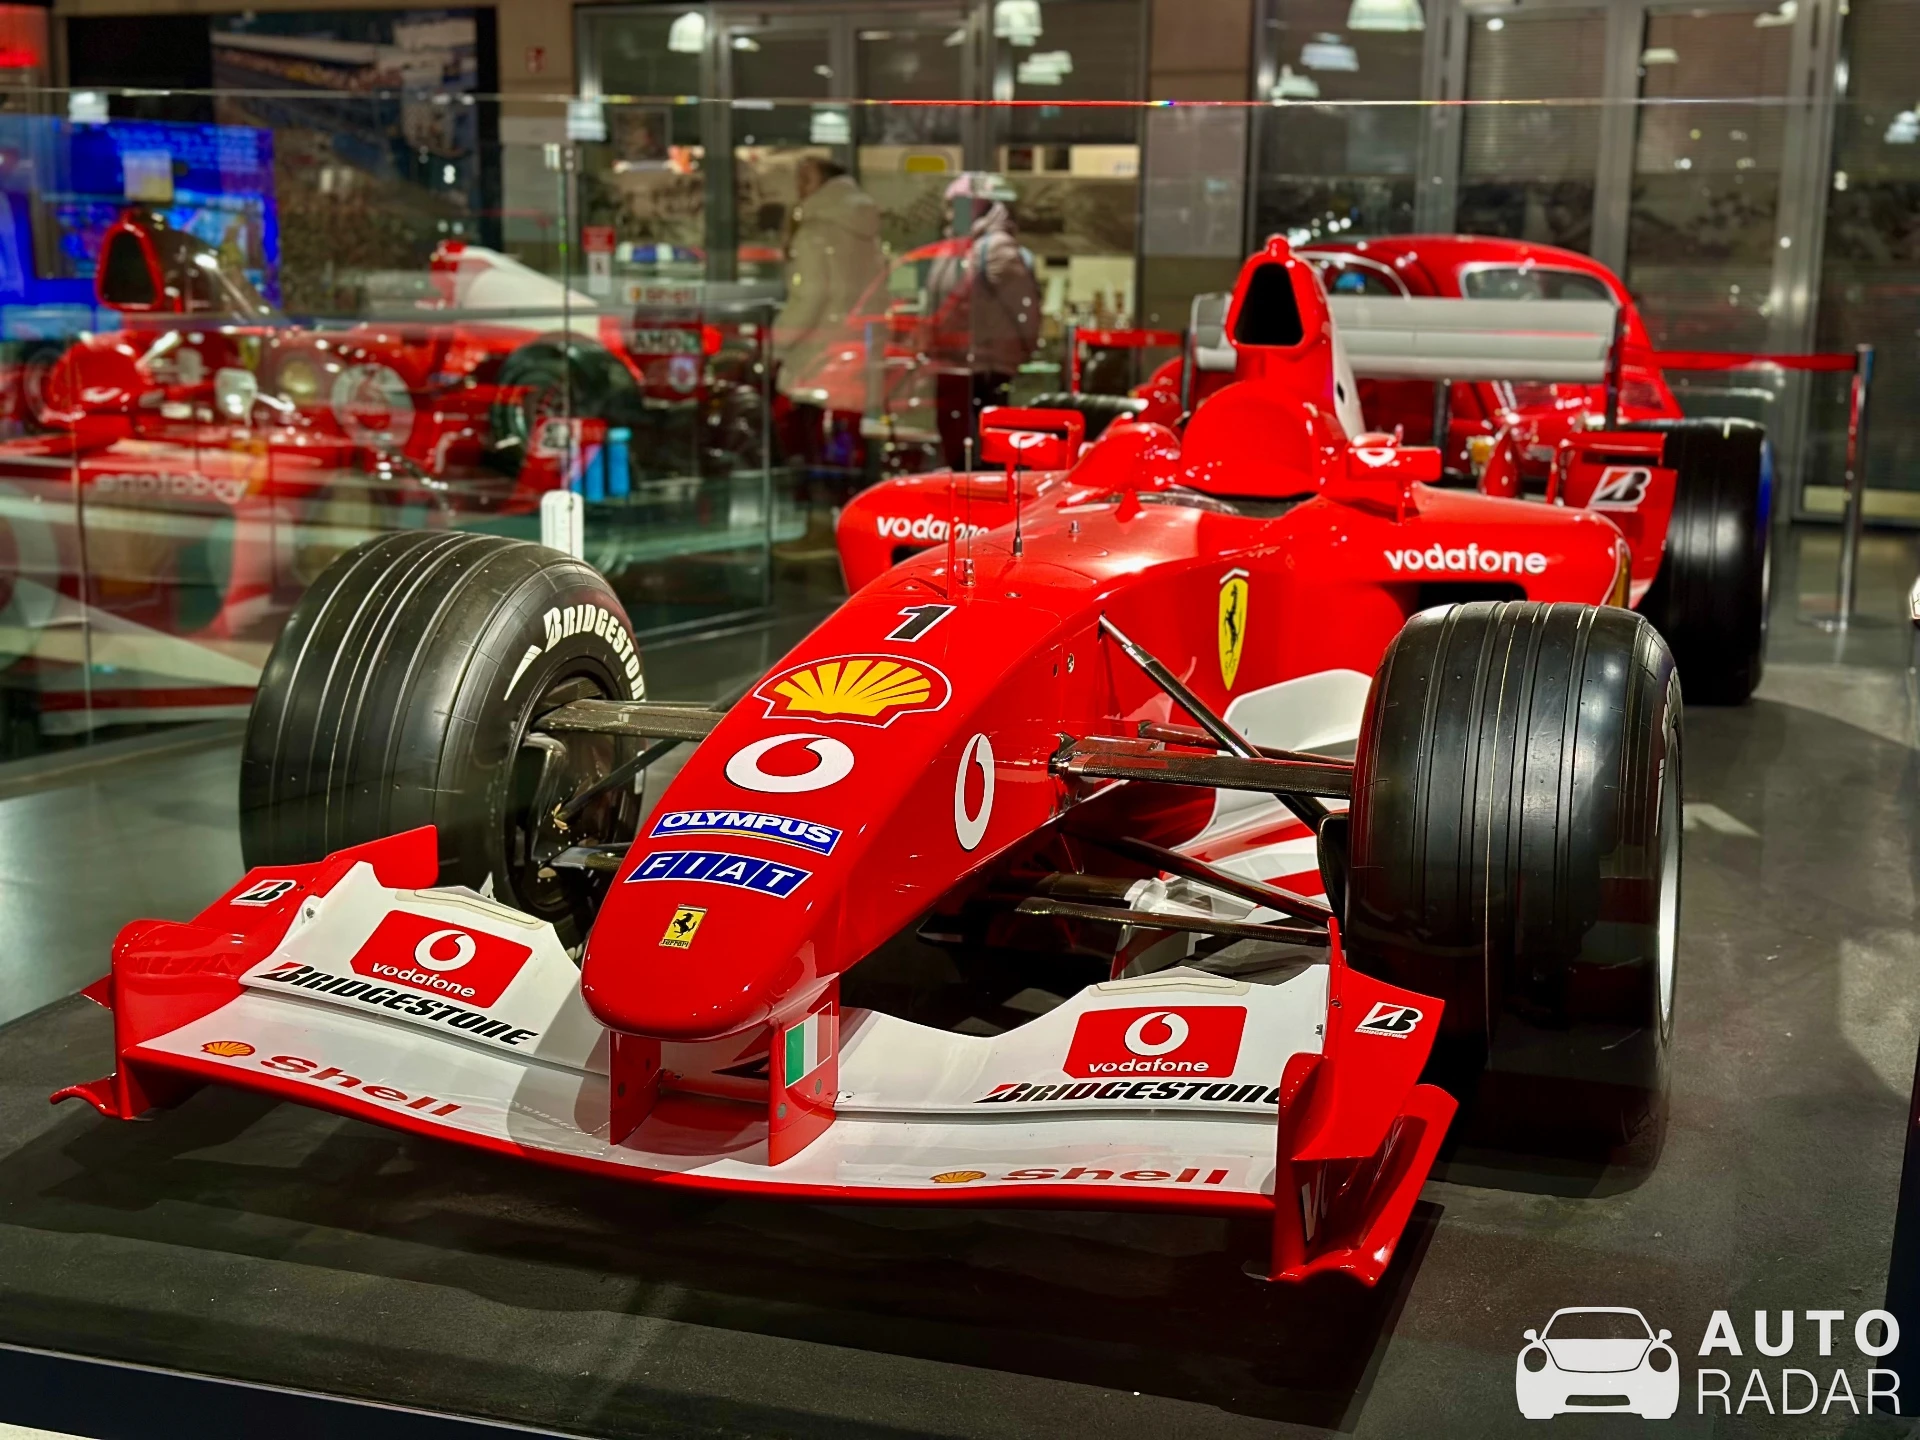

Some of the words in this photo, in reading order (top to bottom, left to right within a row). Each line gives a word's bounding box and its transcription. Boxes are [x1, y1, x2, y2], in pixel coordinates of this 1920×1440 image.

[1384, 542, 1548, 575] vodafone
[883, 603, 957, 643] 1
[543, 603, 647, 702] BRIDGESTON
[662, 812, 834, 844] OLYMPUS
[642, 856, 796, 888] FIAT
[372, 961, 477, 998] vodafone
[253, 961, 540, 1046] BRIDGESTONE
[1088, 1055, 1210, 1074] vodafone
[260, 1055, 462, 1117] Shell
[1000, 1167, 1230, 1185] Shell
